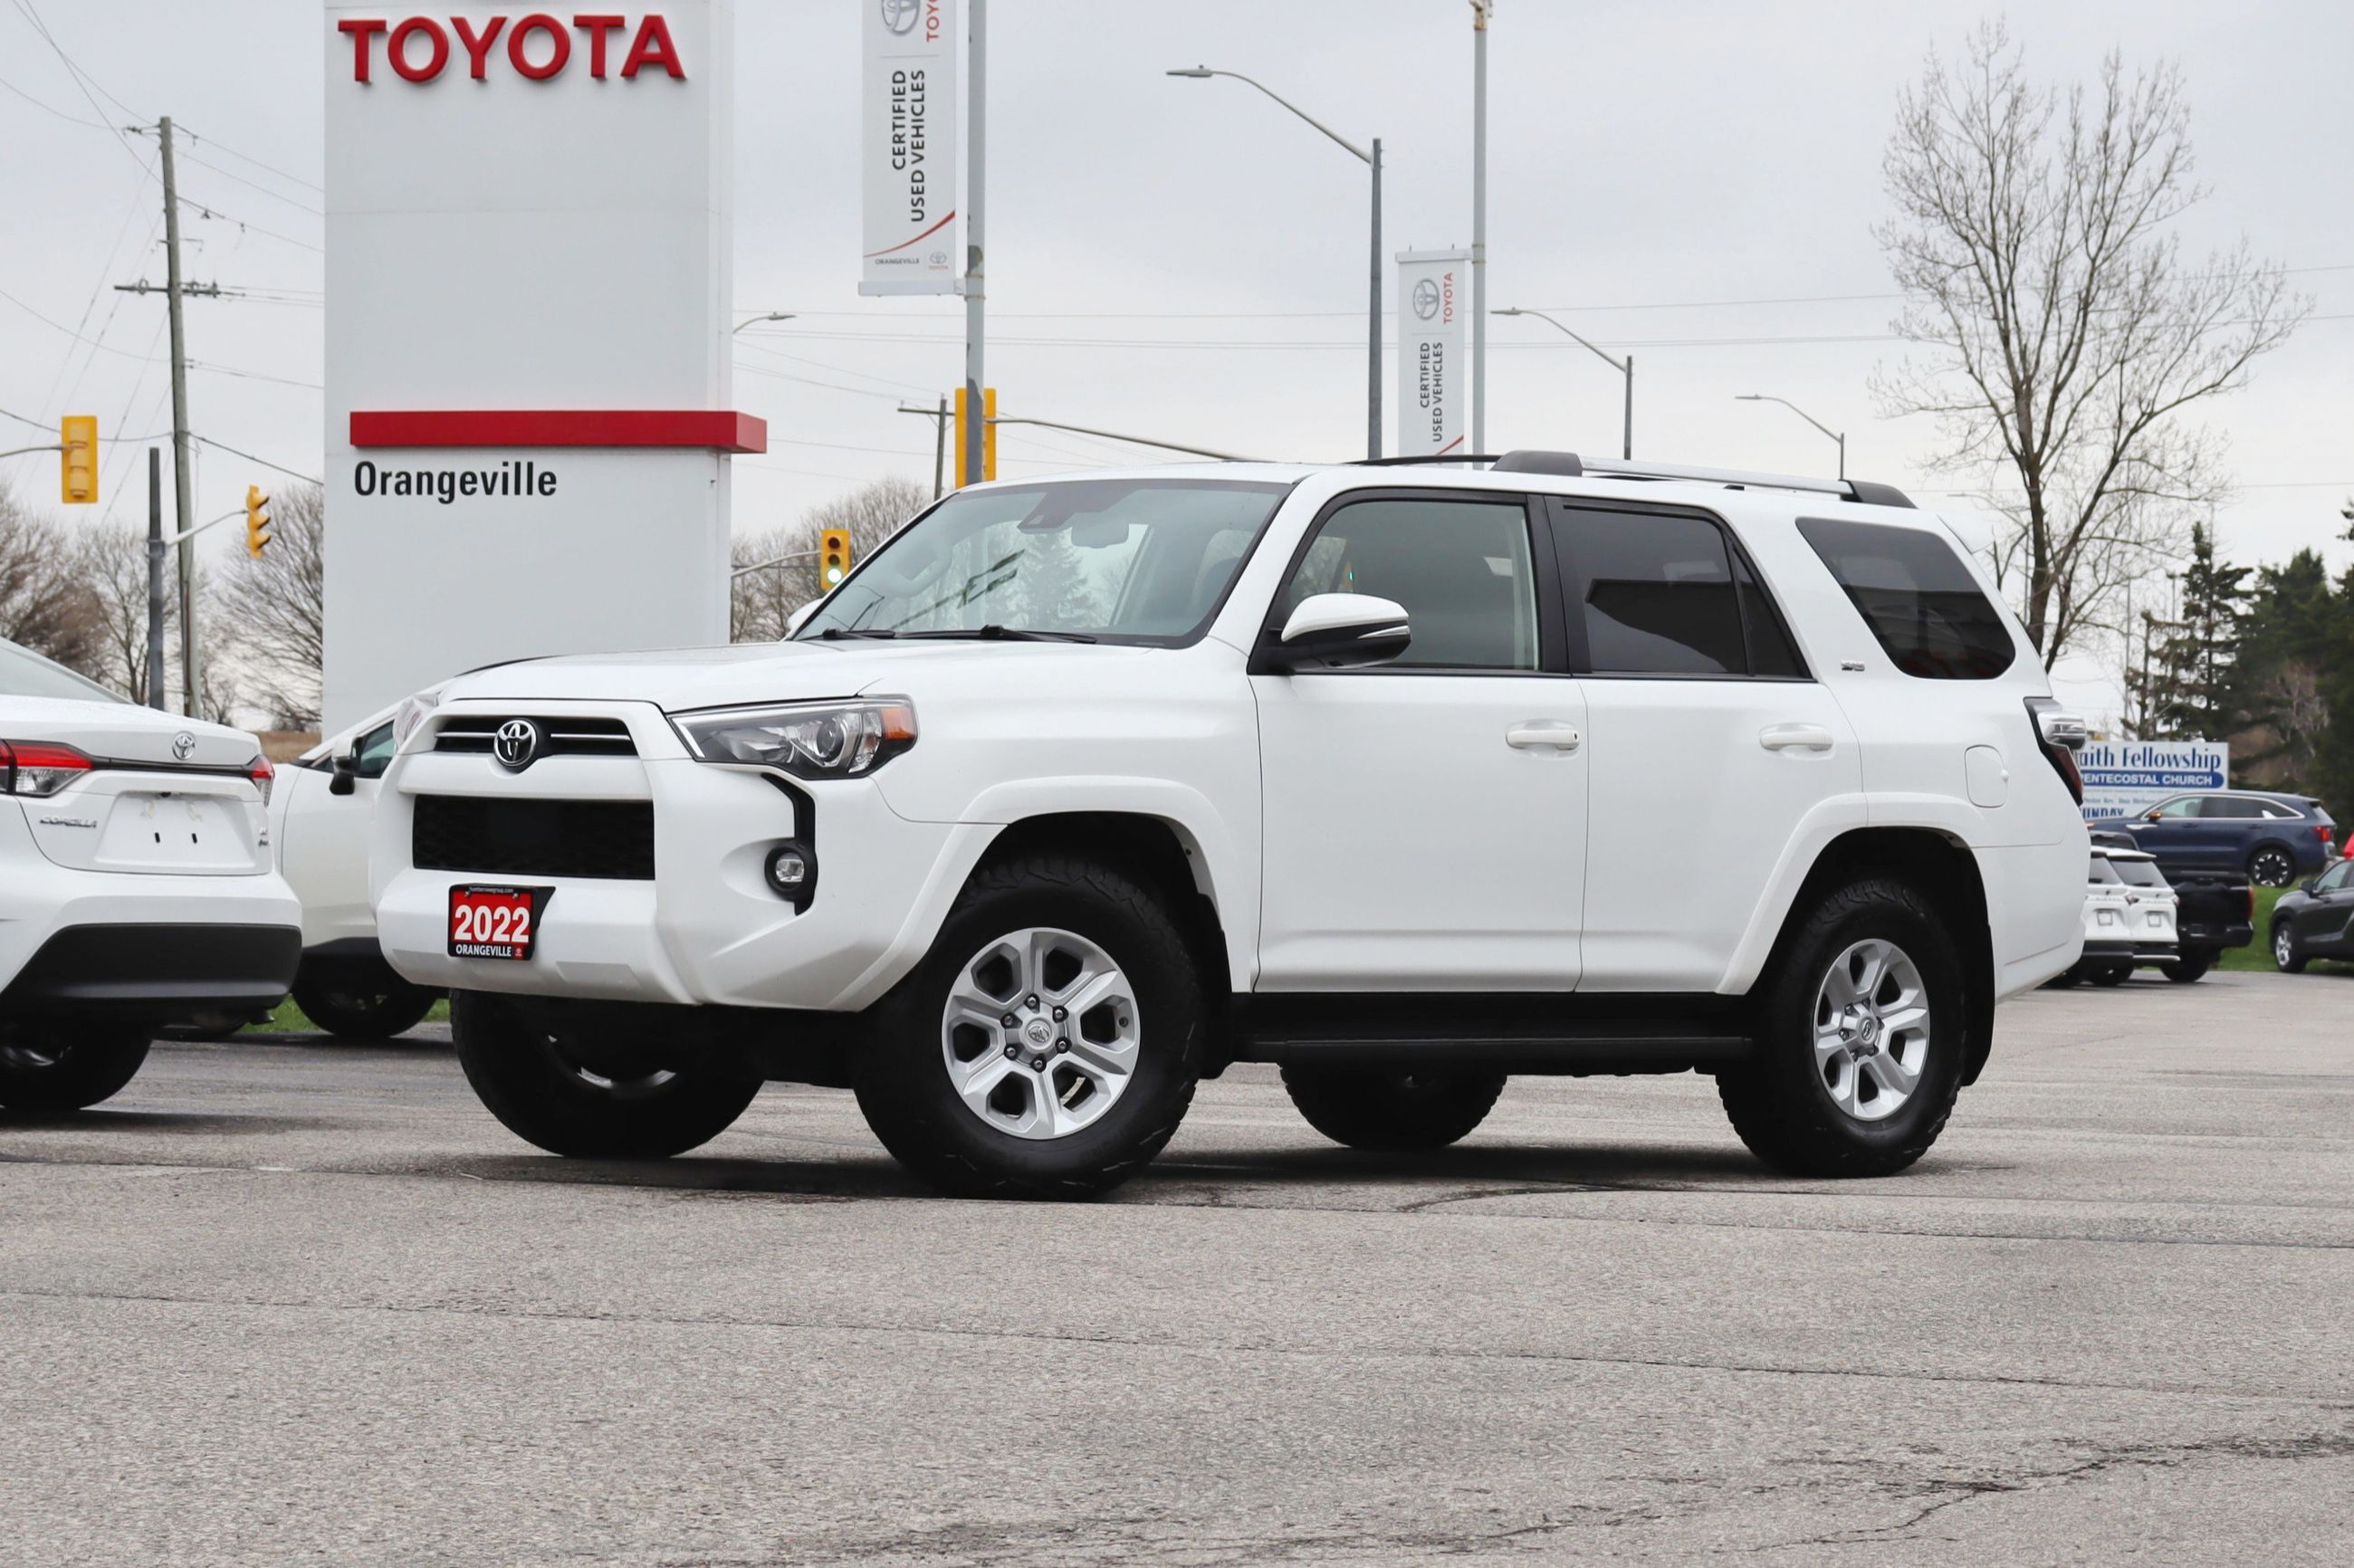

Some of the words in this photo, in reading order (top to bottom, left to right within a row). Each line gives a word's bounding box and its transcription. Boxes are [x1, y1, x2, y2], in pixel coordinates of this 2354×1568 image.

[926, 0, 939, 43] TOY
[338, 14, 686, 82] TOYOTA
[892, 70, 906, 170] CERTIFIED
[911, 70, 925, 164] VEHICLES
[911, 170, 925, 222] USED
[1443, 272, 1453, 324] TOYOTA
[1420, 342, 1431, 408] CERTIFIED
[1432, 342, 1443, 404] VEHICLES
[1432, 406, 1443, 442] USED
[354, 462, 558, 504] Orangeville
[2080, 746, 2115, 768] aith
[2122, 746, 2221, 770] Fellowship
[2082, 773, 2159, 785] ENTECOSTAL
[2162, 775, 2213, 786] CHURCH
[2082, 808, 2124, 818] UNDAY
[454, 904, 530, 942] 2022
[455, 943, 512, 957] ORANGEVILLE
